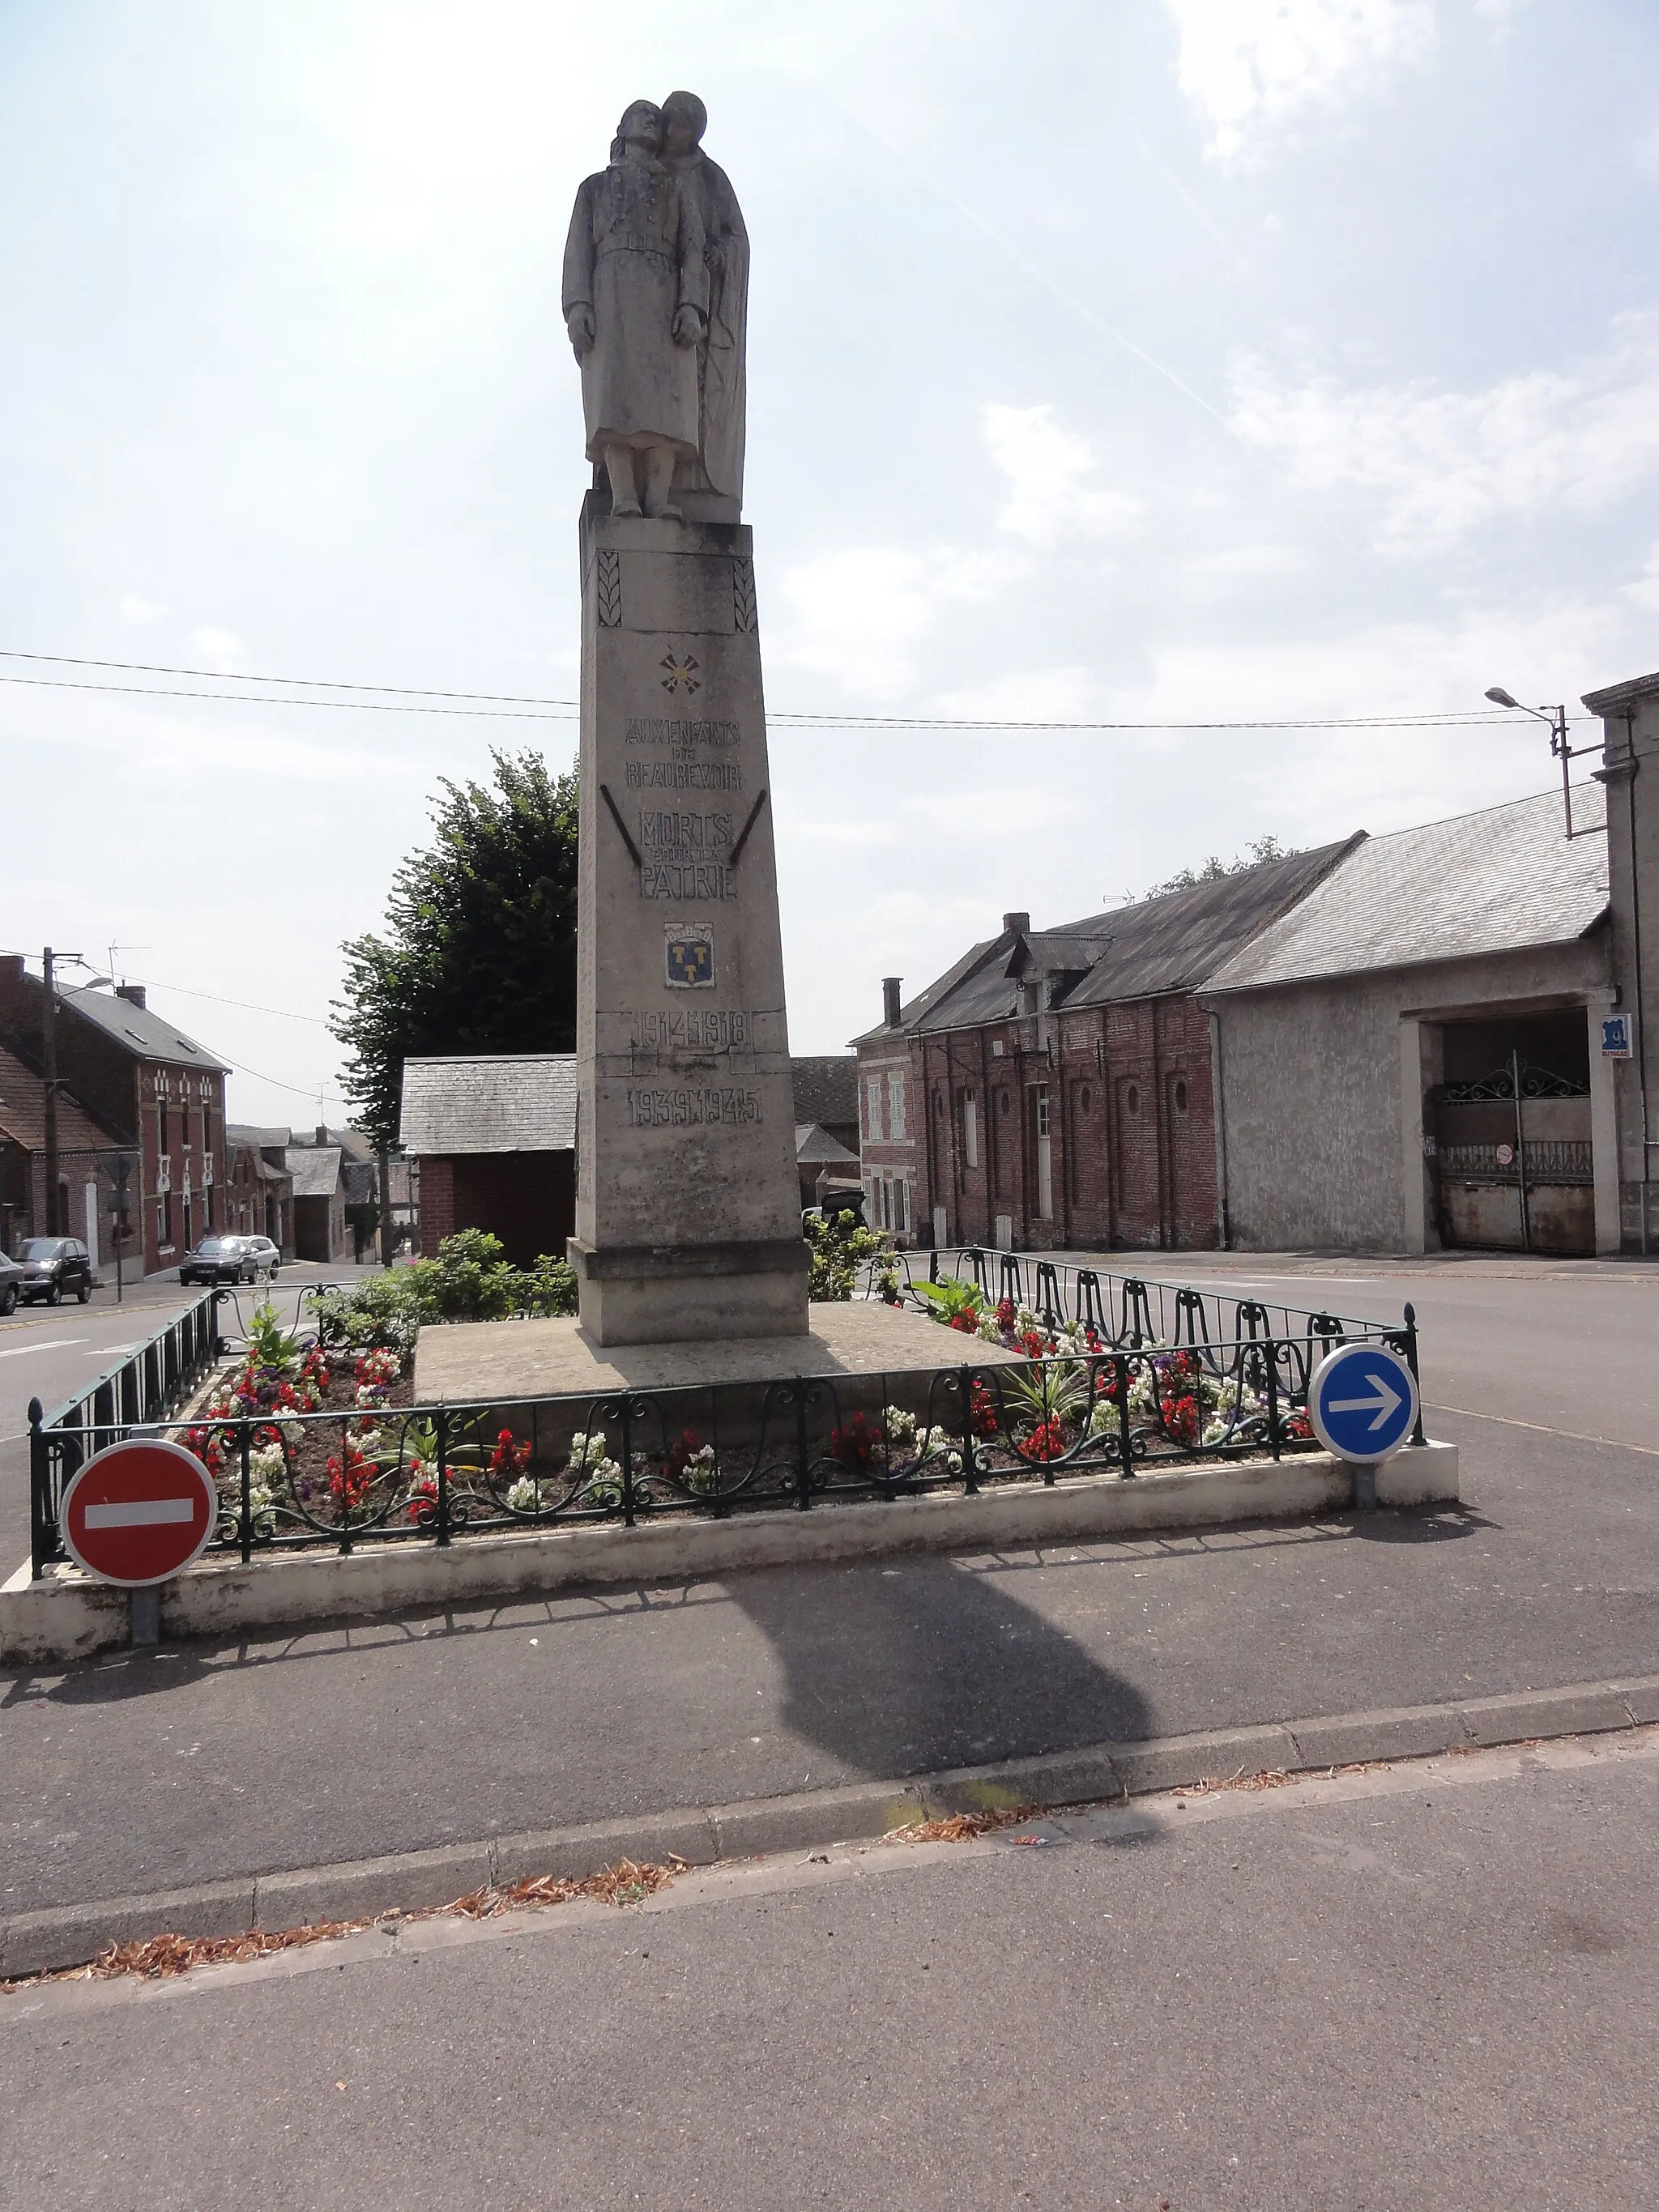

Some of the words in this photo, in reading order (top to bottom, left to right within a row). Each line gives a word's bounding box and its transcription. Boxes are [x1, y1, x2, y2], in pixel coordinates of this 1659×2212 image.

[639, 812, 733, 846] MORTS
[652, 849, 693, 863] POUR
[698, 850, 722, 863] LA
[640, 865, 738, 900] PATRIE
[635, 1012, 689, 1046] 1914
[692, 1012, 747, 1046] 1918
[628, 1089, 688, 1127] 1939
[697, 1089, 763, 1125] 1945
